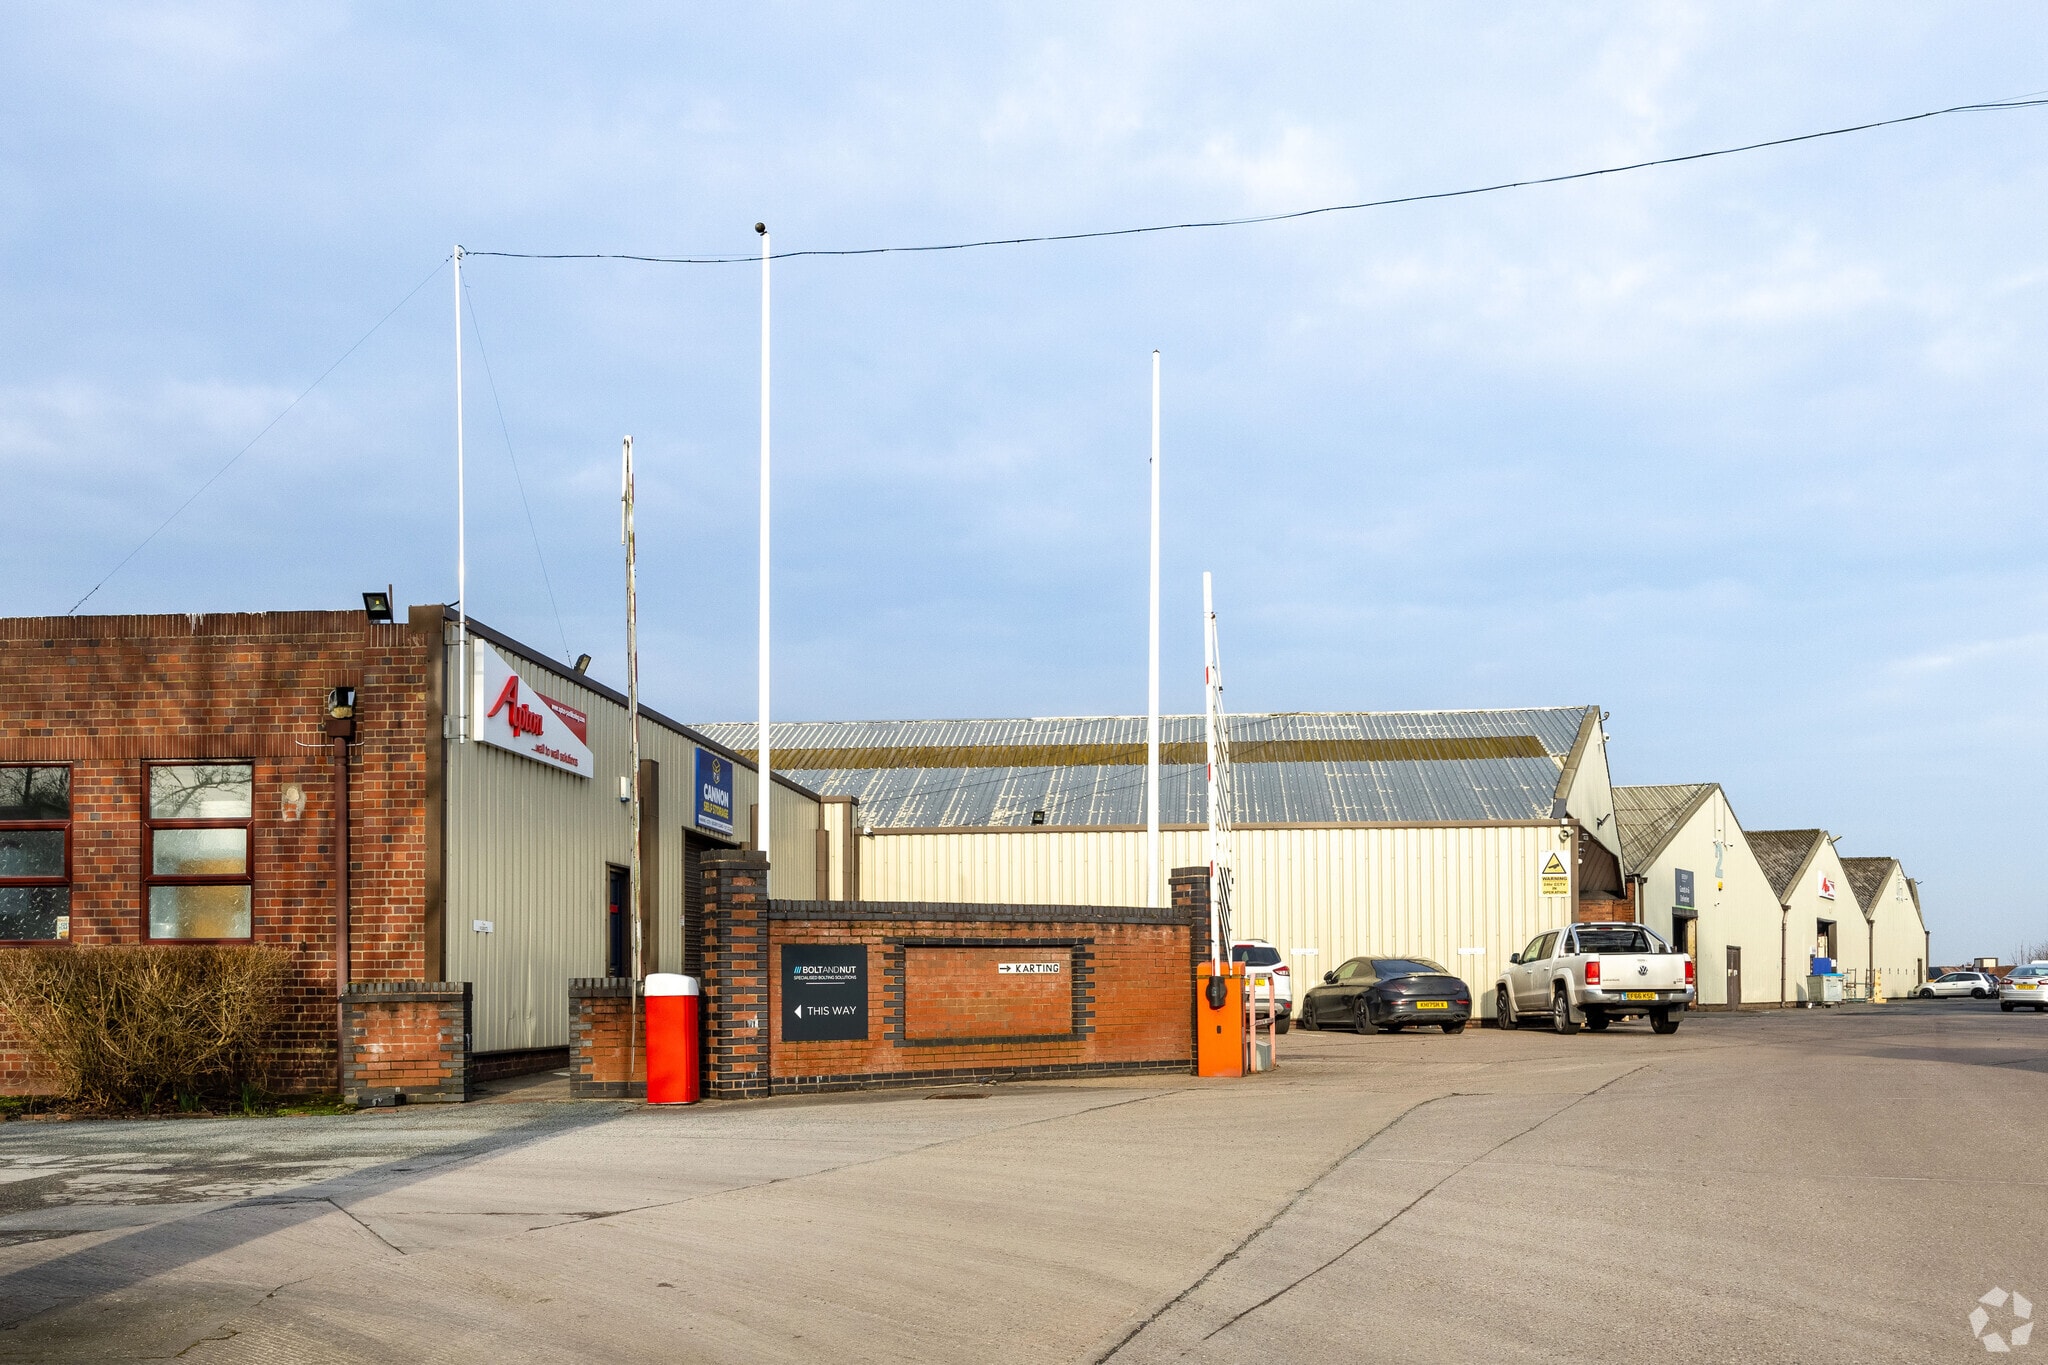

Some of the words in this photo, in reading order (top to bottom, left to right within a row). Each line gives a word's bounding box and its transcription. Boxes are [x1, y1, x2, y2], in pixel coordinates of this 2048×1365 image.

[487, 675, 544, 737] Apton
[703, 783, 729, 808] CANNON
[713, 803, 729, 819] STORAGE
[802, 966, 857, 974] BOLTANDNUT
[1015, 964, 1059, 973] KARTING
[807, 1006, 830, 1016] THIS
[831, 1006, 857, 1015] WAY
